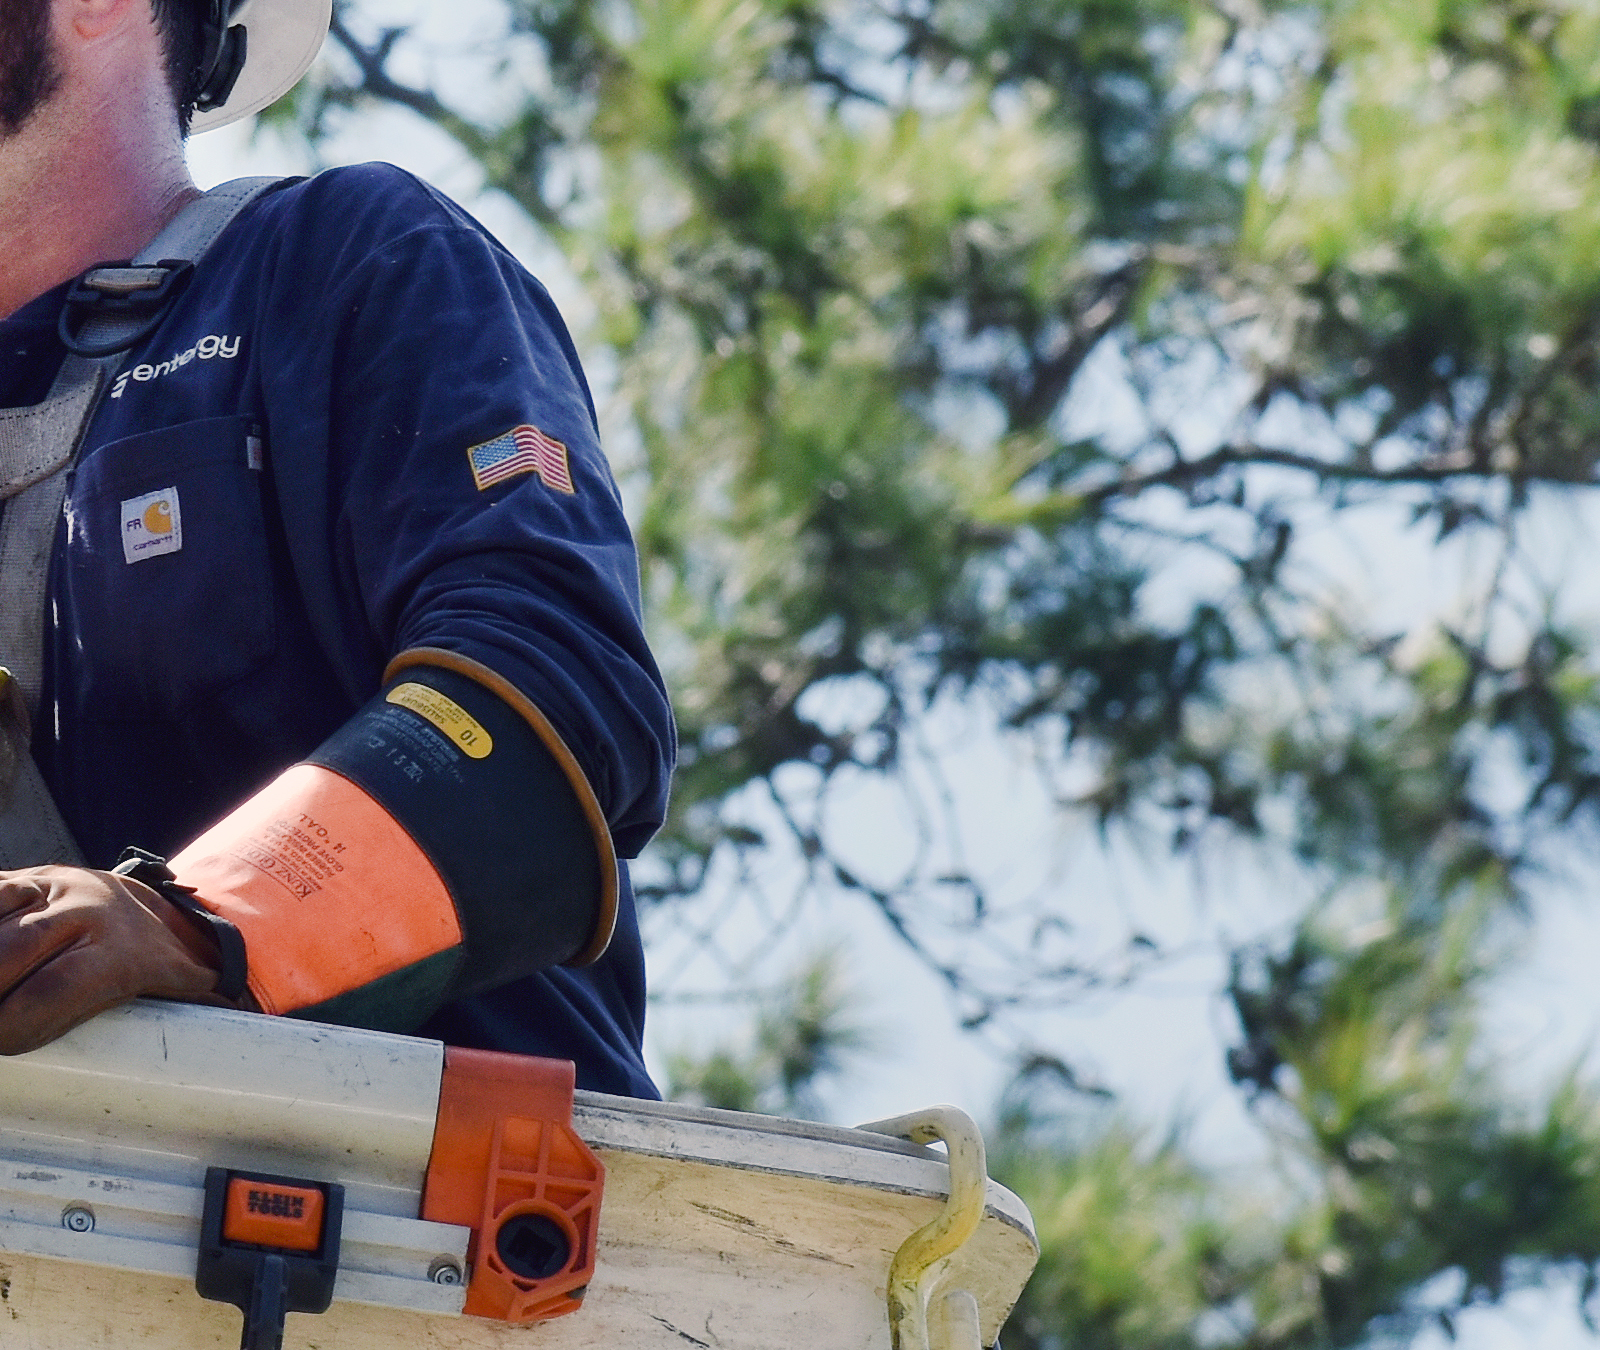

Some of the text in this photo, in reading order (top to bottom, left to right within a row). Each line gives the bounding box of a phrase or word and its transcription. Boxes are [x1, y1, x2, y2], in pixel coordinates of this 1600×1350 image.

[126, 518, 142, 532] FR
[402, 696, 446, 725] SALISBURY
[460, 730, 478, 747] 10
[275, 866, 312, 898] KUNZ
[249, 1190, 304, 1207] KLEIN
[249, 1203, 302, 1219] TOOLS
